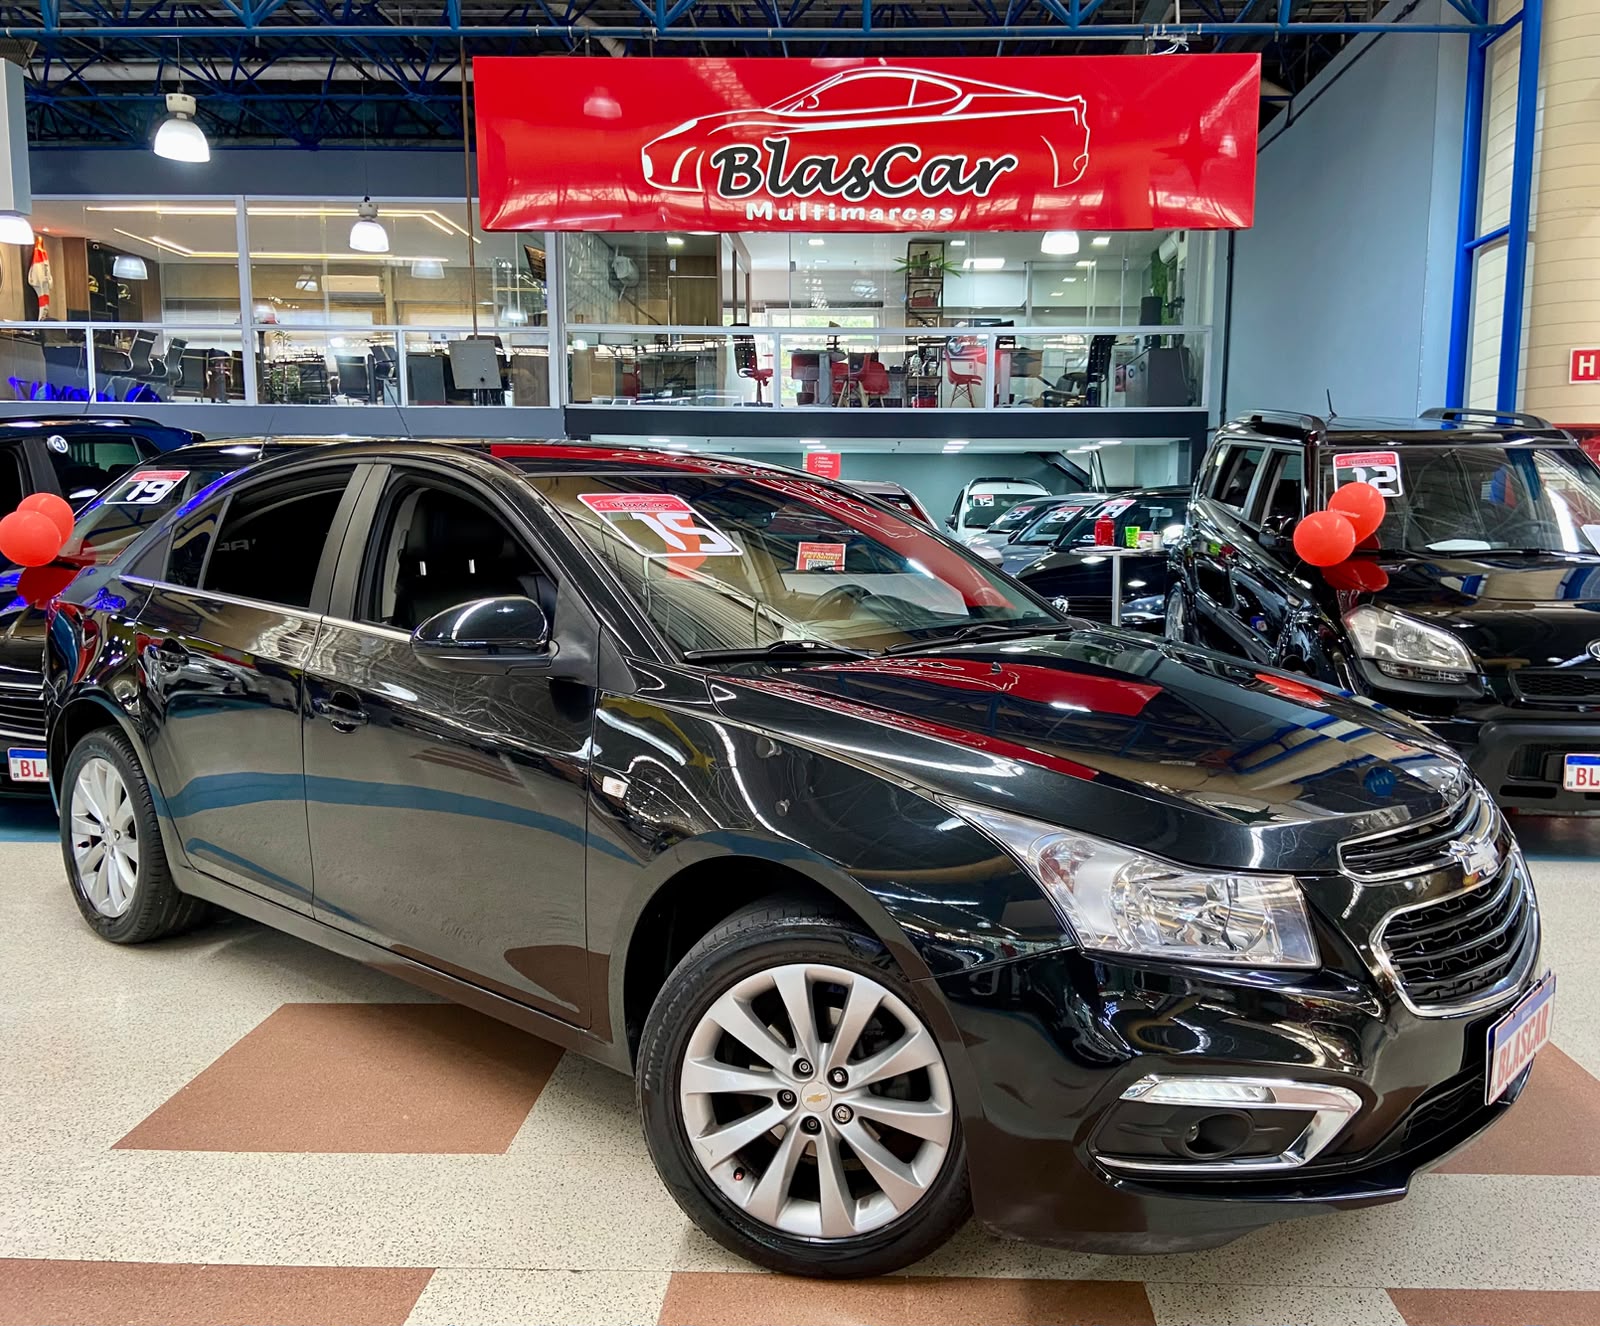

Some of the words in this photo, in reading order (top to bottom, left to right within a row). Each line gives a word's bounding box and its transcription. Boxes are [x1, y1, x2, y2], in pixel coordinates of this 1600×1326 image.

[711, 138, 1017, 200] BlasCar
[746, 202, 954, 221] Multimarcas
[1578, 354, 1596, 376] H
[126, 481, 174, 502] 19
[1352, 466, 1397, 494] 12
[631, 513, 733, 552] 15
[20, 760, 49, 778] BL
[1497, 1003, 1549, 1091] BLASCAR
